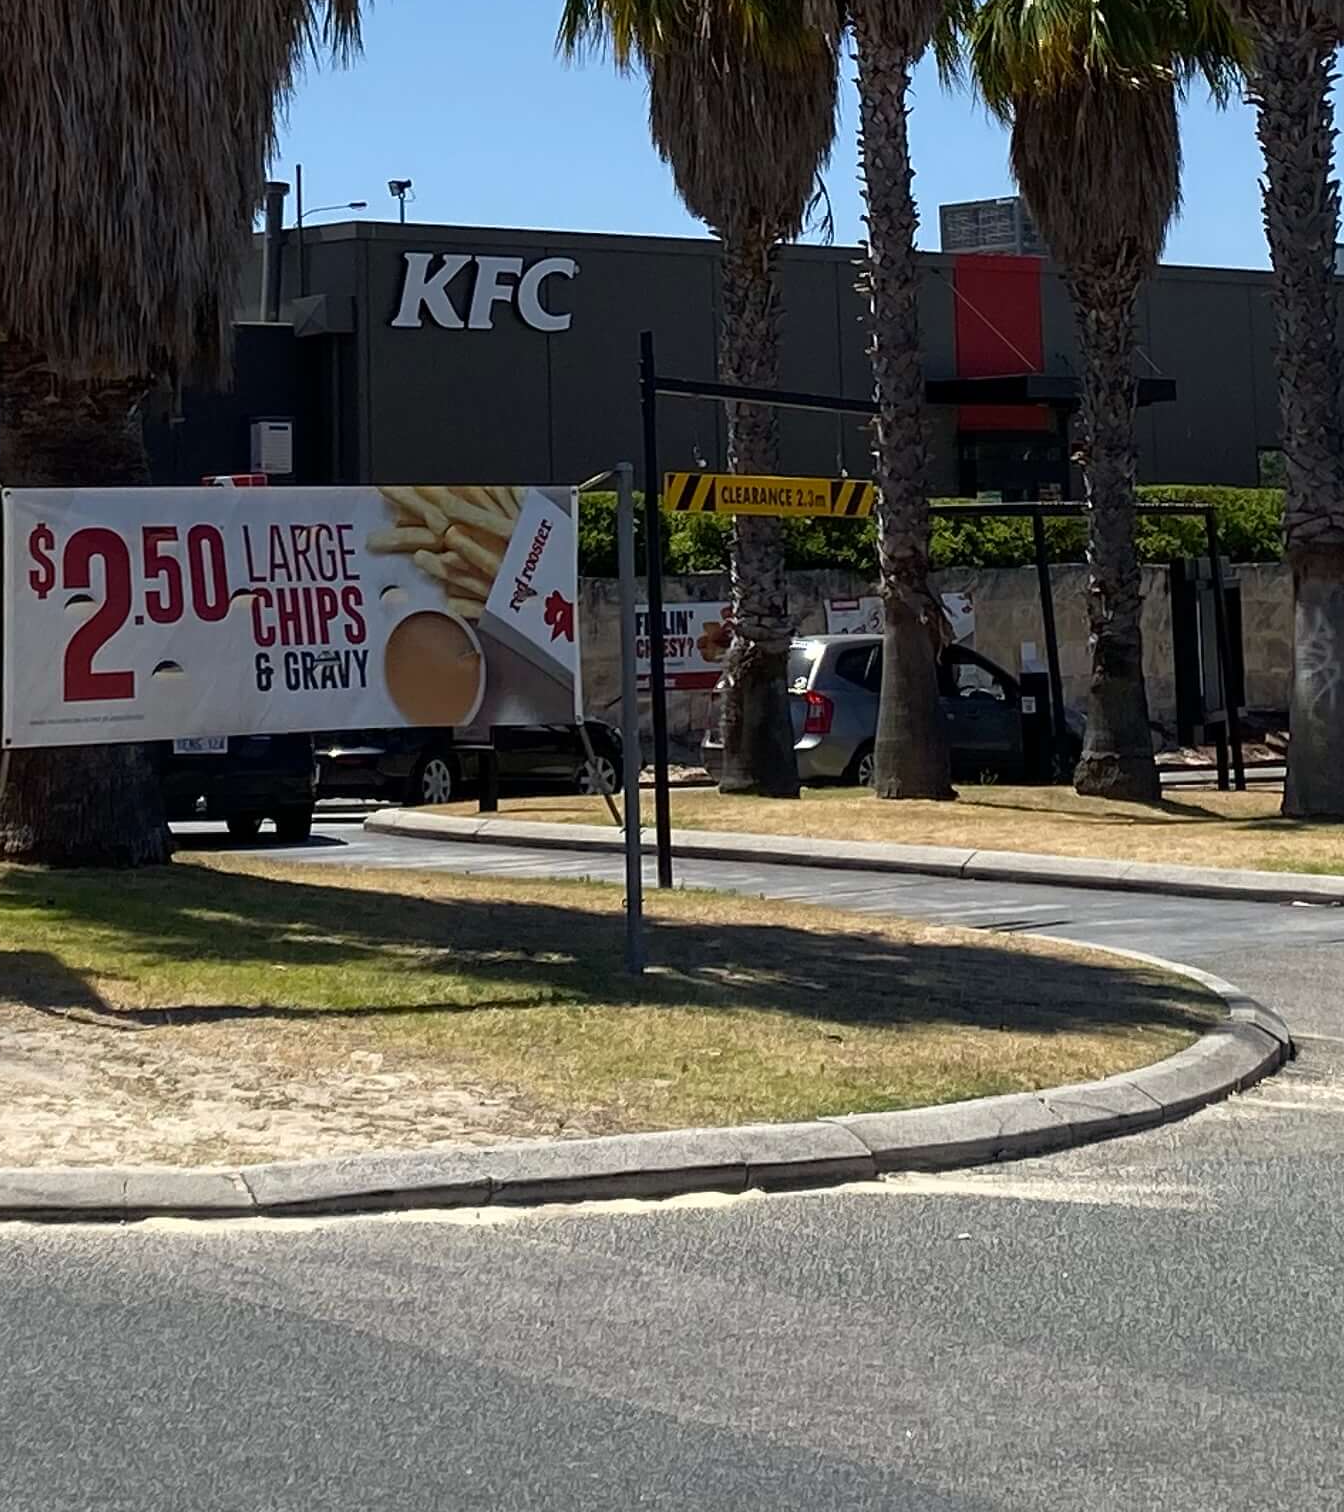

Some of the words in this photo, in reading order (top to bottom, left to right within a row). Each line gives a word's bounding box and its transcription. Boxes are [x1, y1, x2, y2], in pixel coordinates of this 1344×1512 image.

[391, 252, 577, 332] KFC
[721, 485, 793, 506] CLEARANCE
[797, 488, 827, 508] 2.3m
[242, 524, 361, 584] LARGE
[521, 519, 553, 581] rooster
[28, 522, 231, 703] $2.50
[251, 585, 367, 648] CHIPS
[255, 651, 275, 691] &
[284, 649, 370, 691] GRAVY
